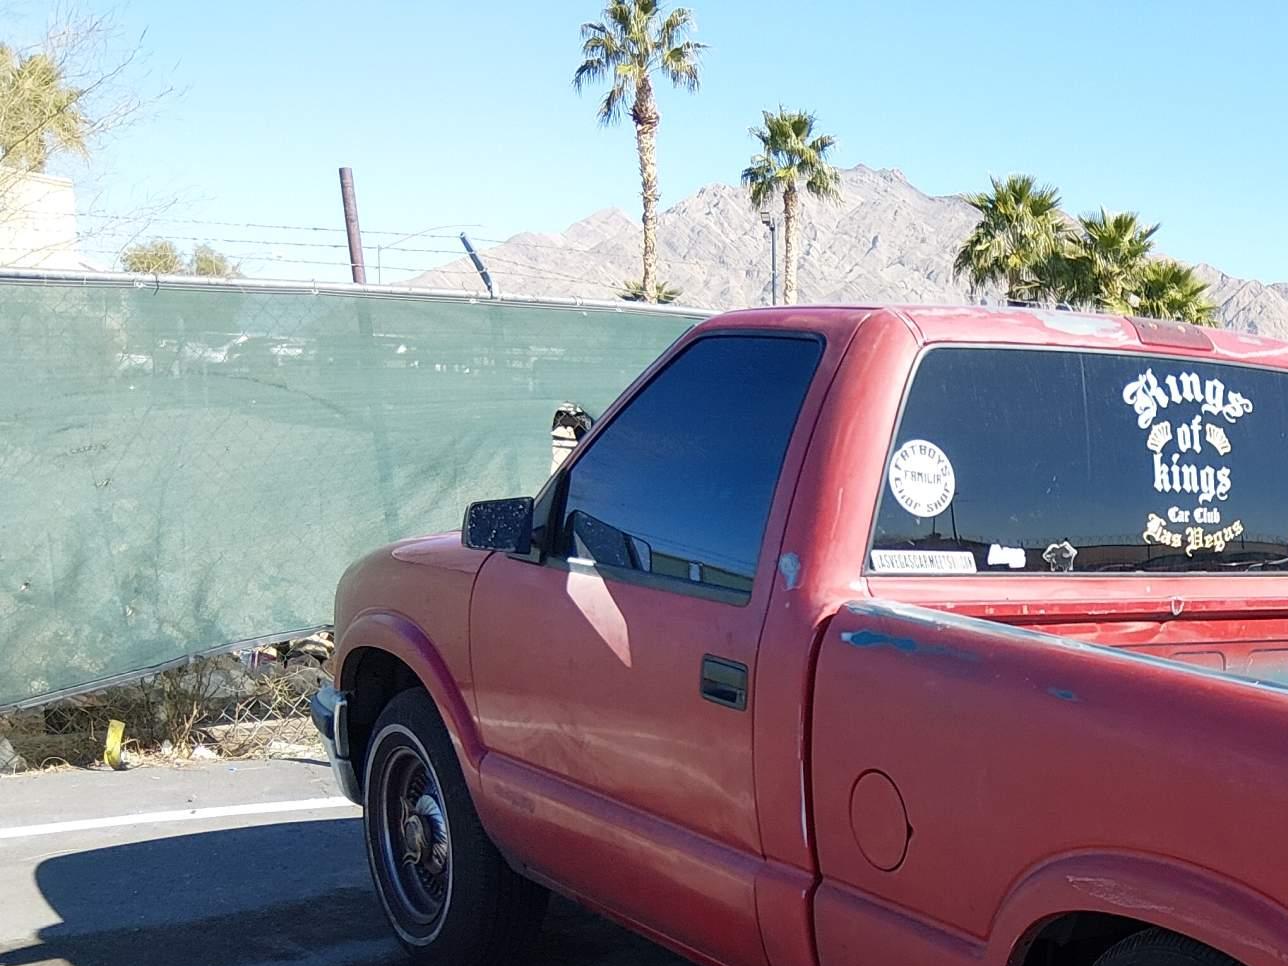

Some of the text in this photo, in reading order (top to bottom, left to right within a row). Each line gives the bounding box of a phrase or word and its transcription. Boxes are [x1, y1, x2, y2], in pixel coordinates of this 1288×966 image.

[1122, 367, 1254, 430] Kings
[1176, 414, 1203, 455] of
[904, 470, 943, 485] FAMILIA
[1152, 451, 1232, 506] kings
[1143, 513, 1245, 558] Las Vegas
[1167, 505, 1222, 525] Car Club
